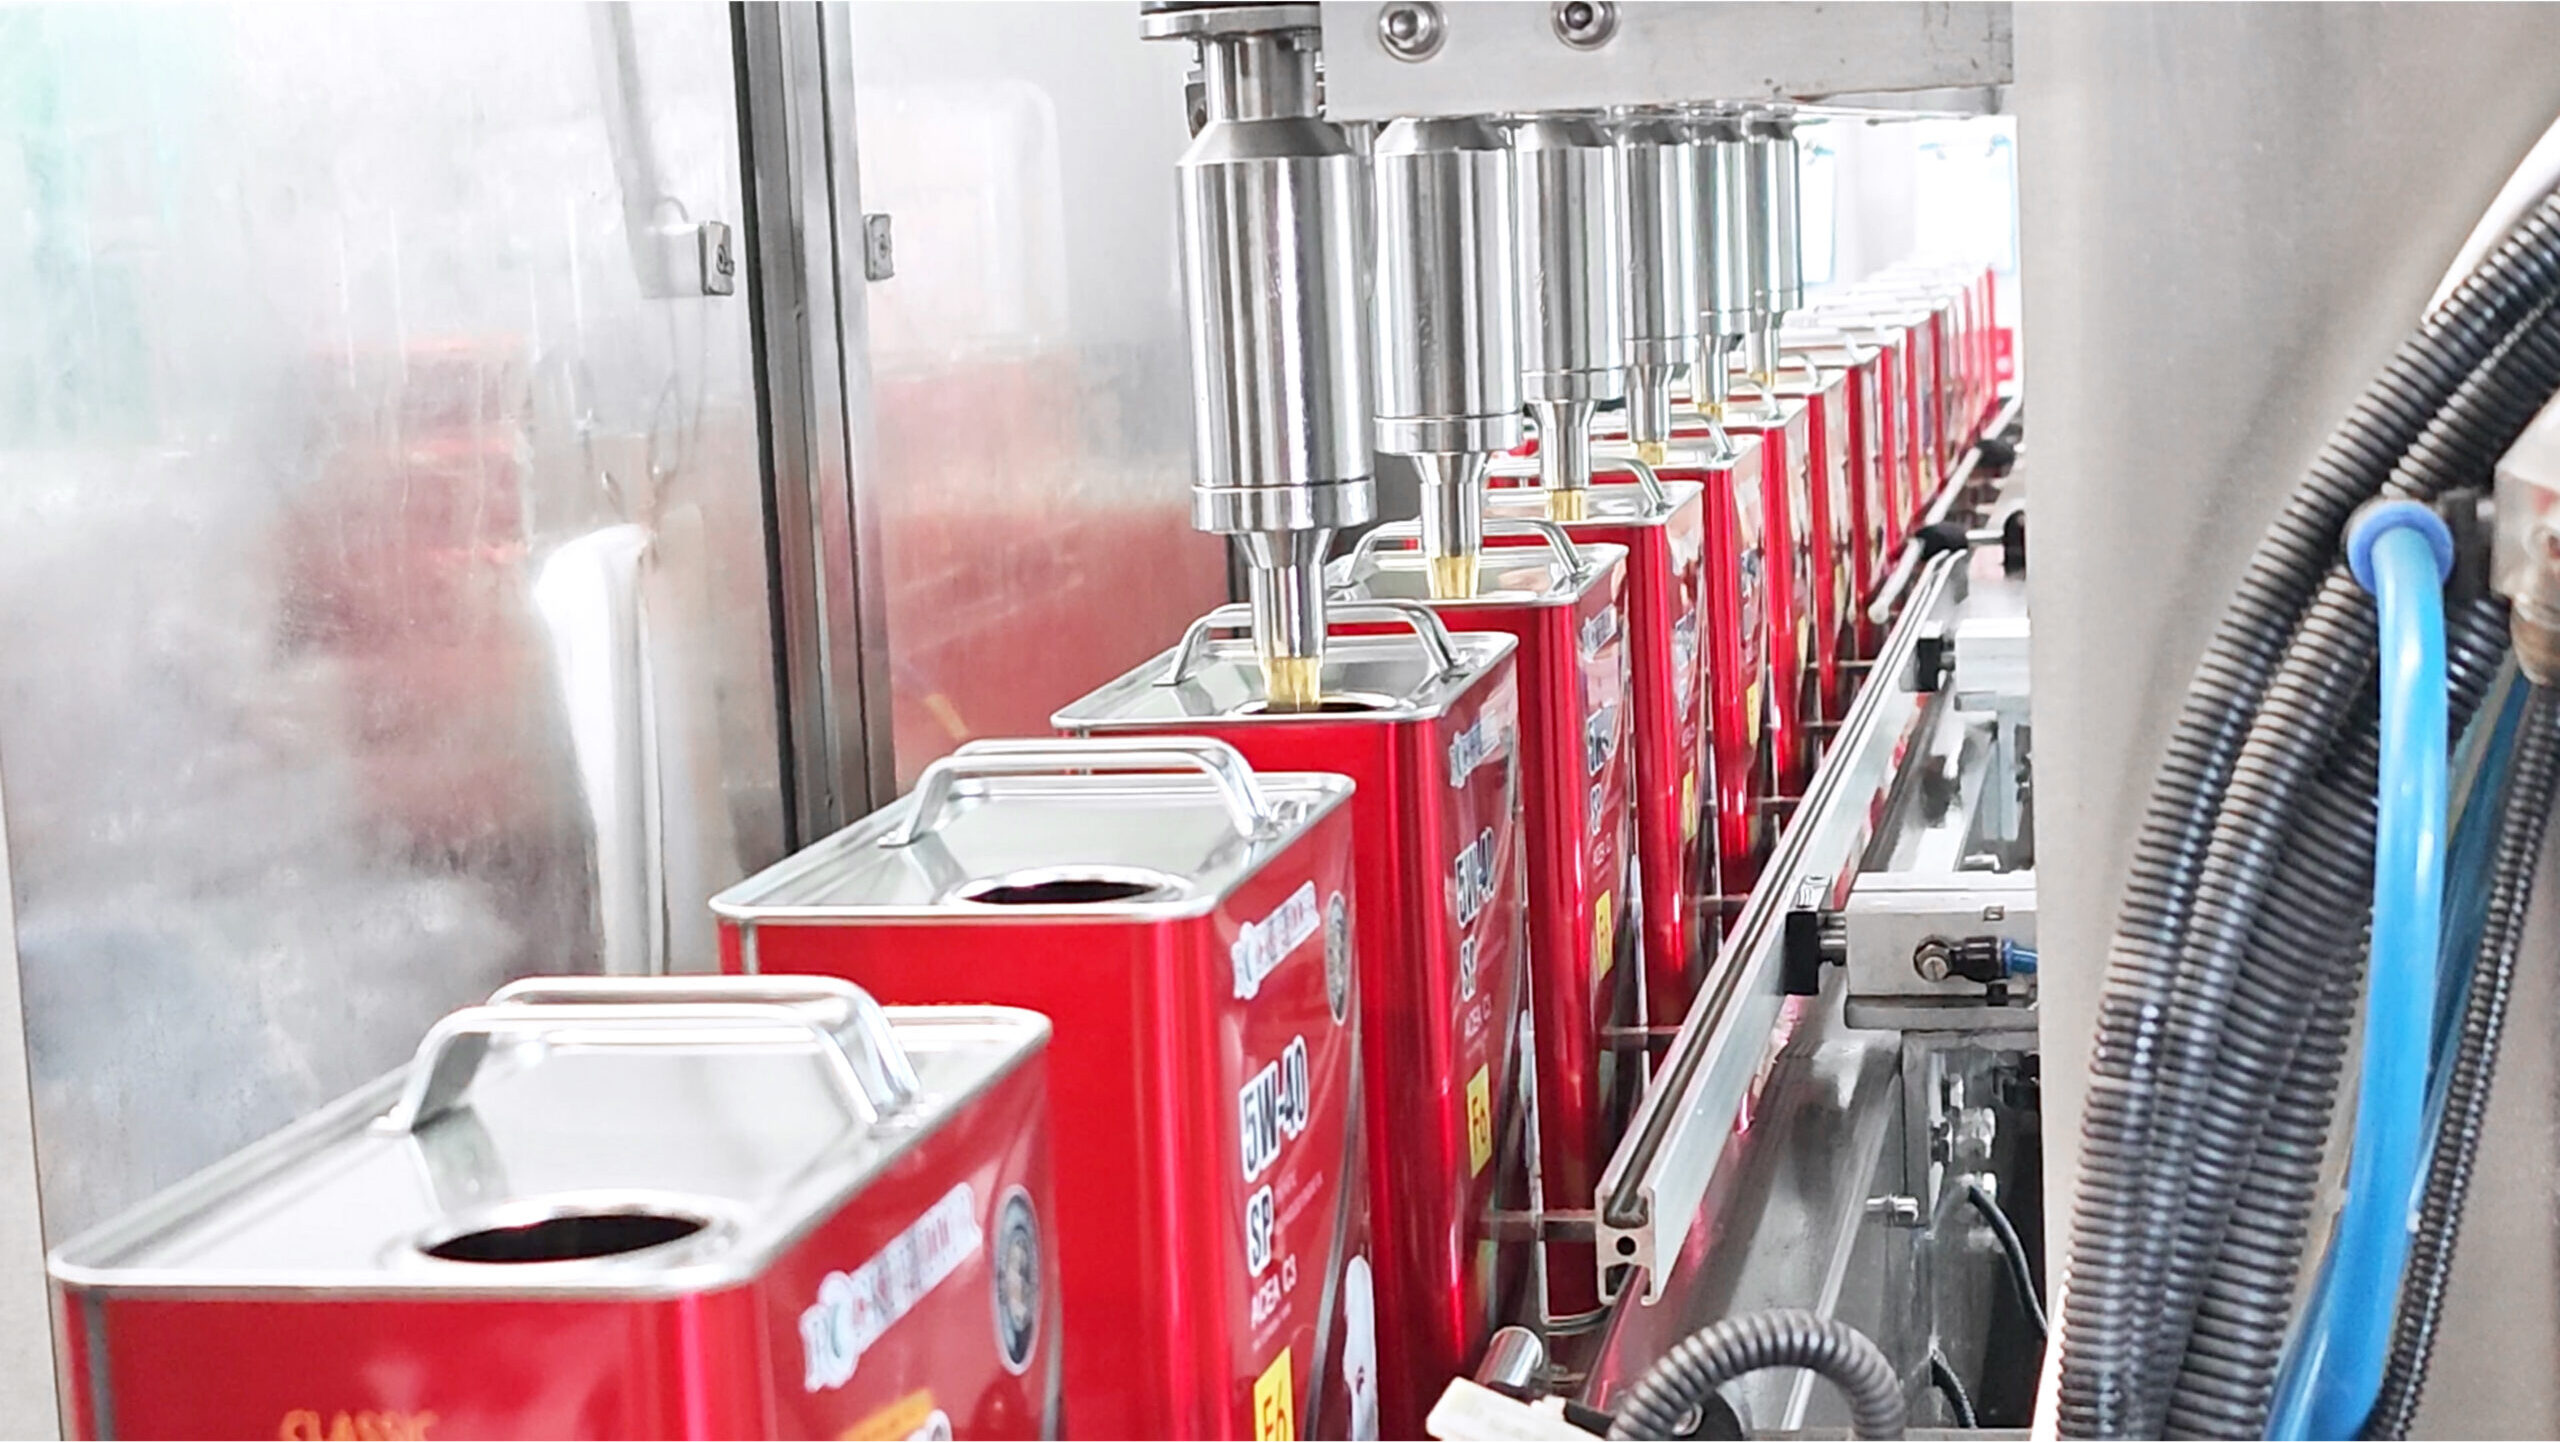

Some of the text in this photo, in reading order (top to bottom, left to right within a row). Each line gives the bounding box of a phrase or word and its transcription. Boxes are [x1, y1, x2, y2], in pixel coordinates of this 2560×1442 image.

[1455, 827, 1494, 929] 5W-40
[1241, 1037, 1308, 1181] 5W-40
[1247, 1185, 1274, 1277] SP
